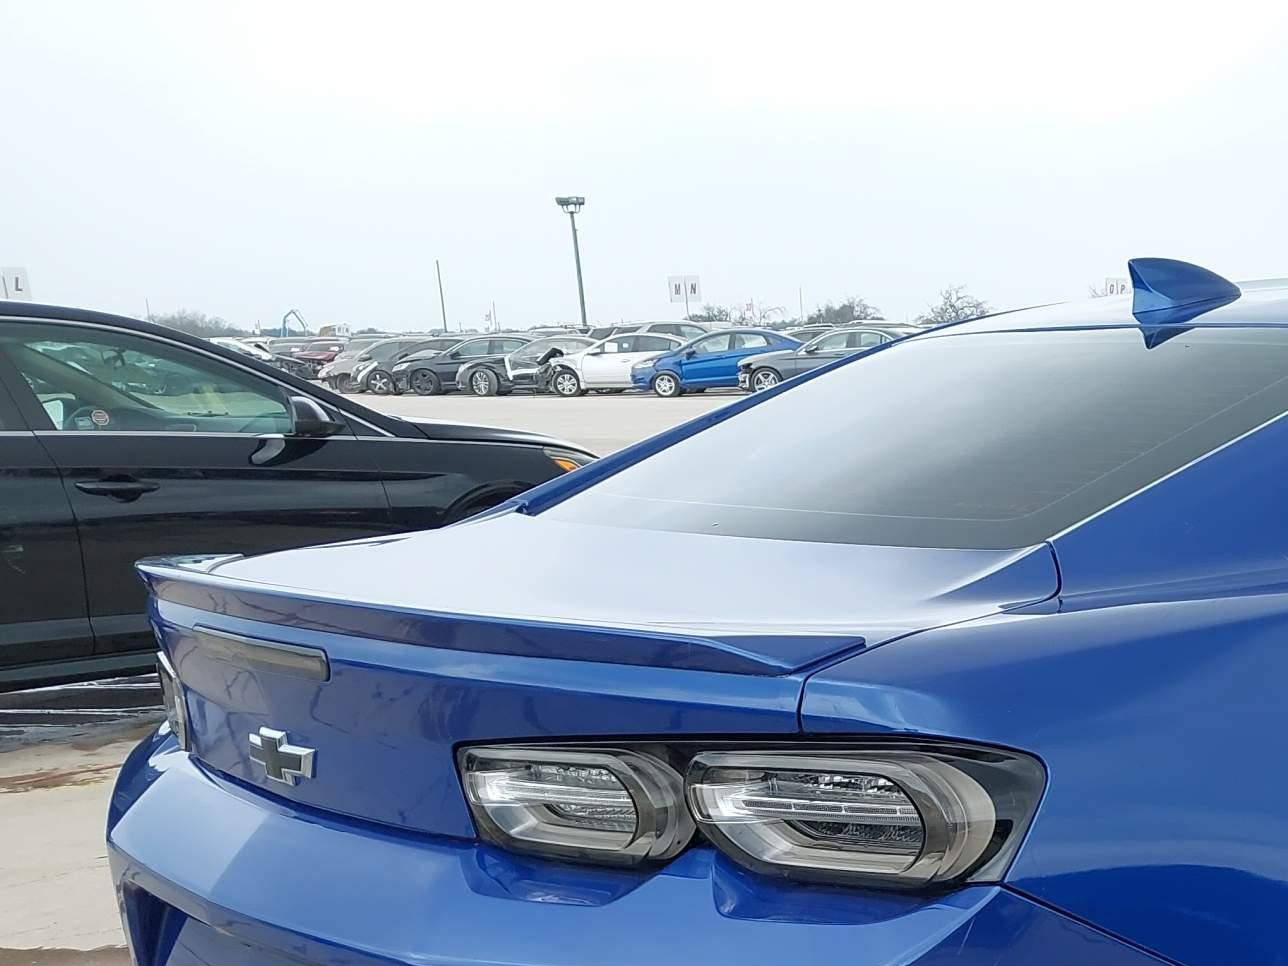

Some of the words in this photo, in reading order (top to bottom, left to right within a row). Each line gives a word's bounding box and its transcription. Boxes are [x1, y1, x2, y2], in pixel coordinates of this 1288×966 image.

[15, 276, 24, 292] L
[674, 283, 681, 295] M
[690, 283, 697, 295] N
